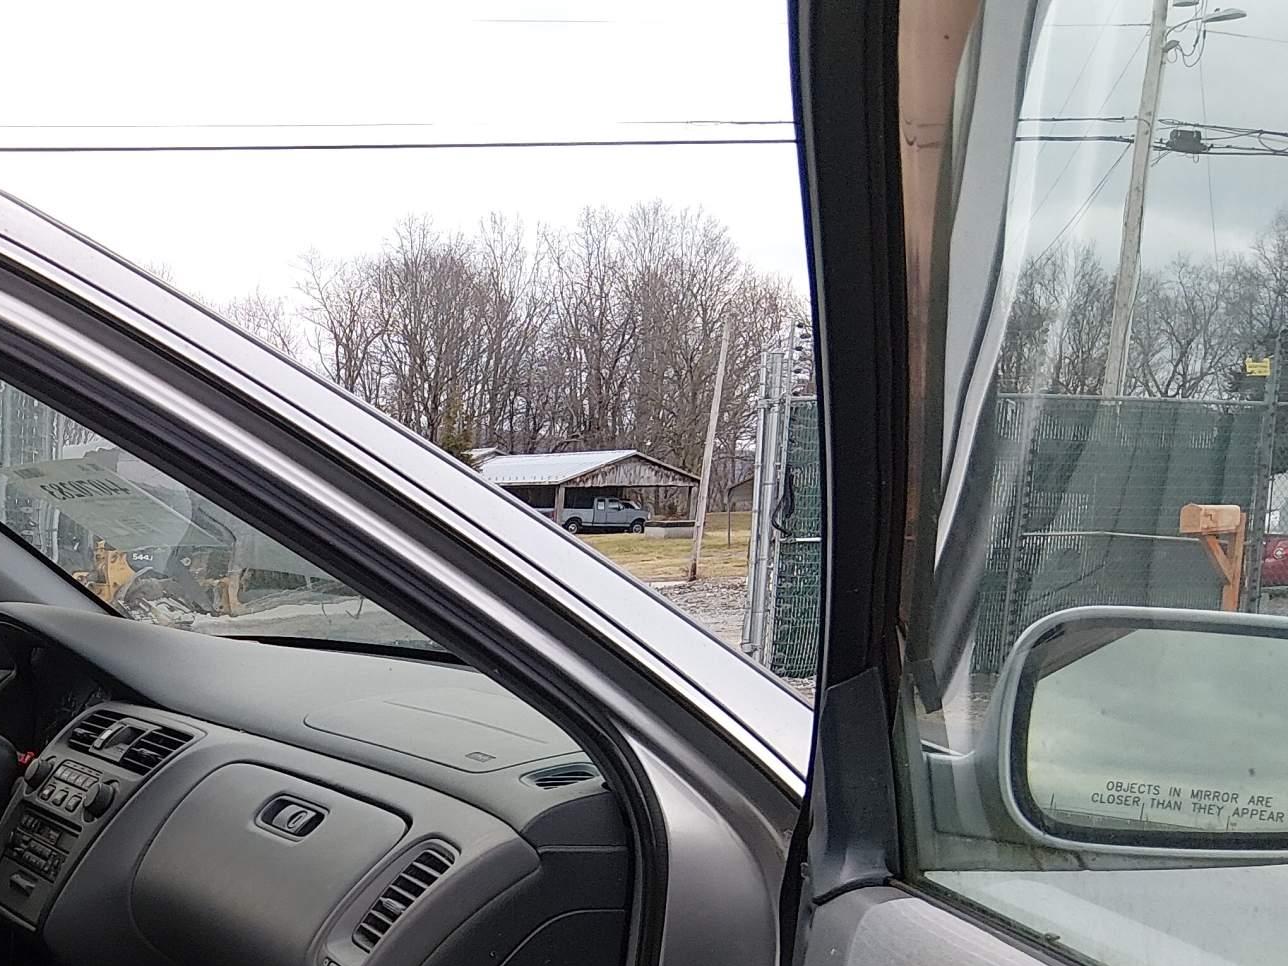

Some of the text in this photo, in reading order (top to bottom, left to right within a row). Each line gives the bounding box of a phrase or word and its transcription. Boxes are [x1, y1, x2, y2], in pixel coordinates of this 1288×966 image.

[1091, 792, 1285, 824] CLOSER THAN THEY APPEAR
[1106, 780, 1274, 808] OBJECTS IN MIRROR ARE
